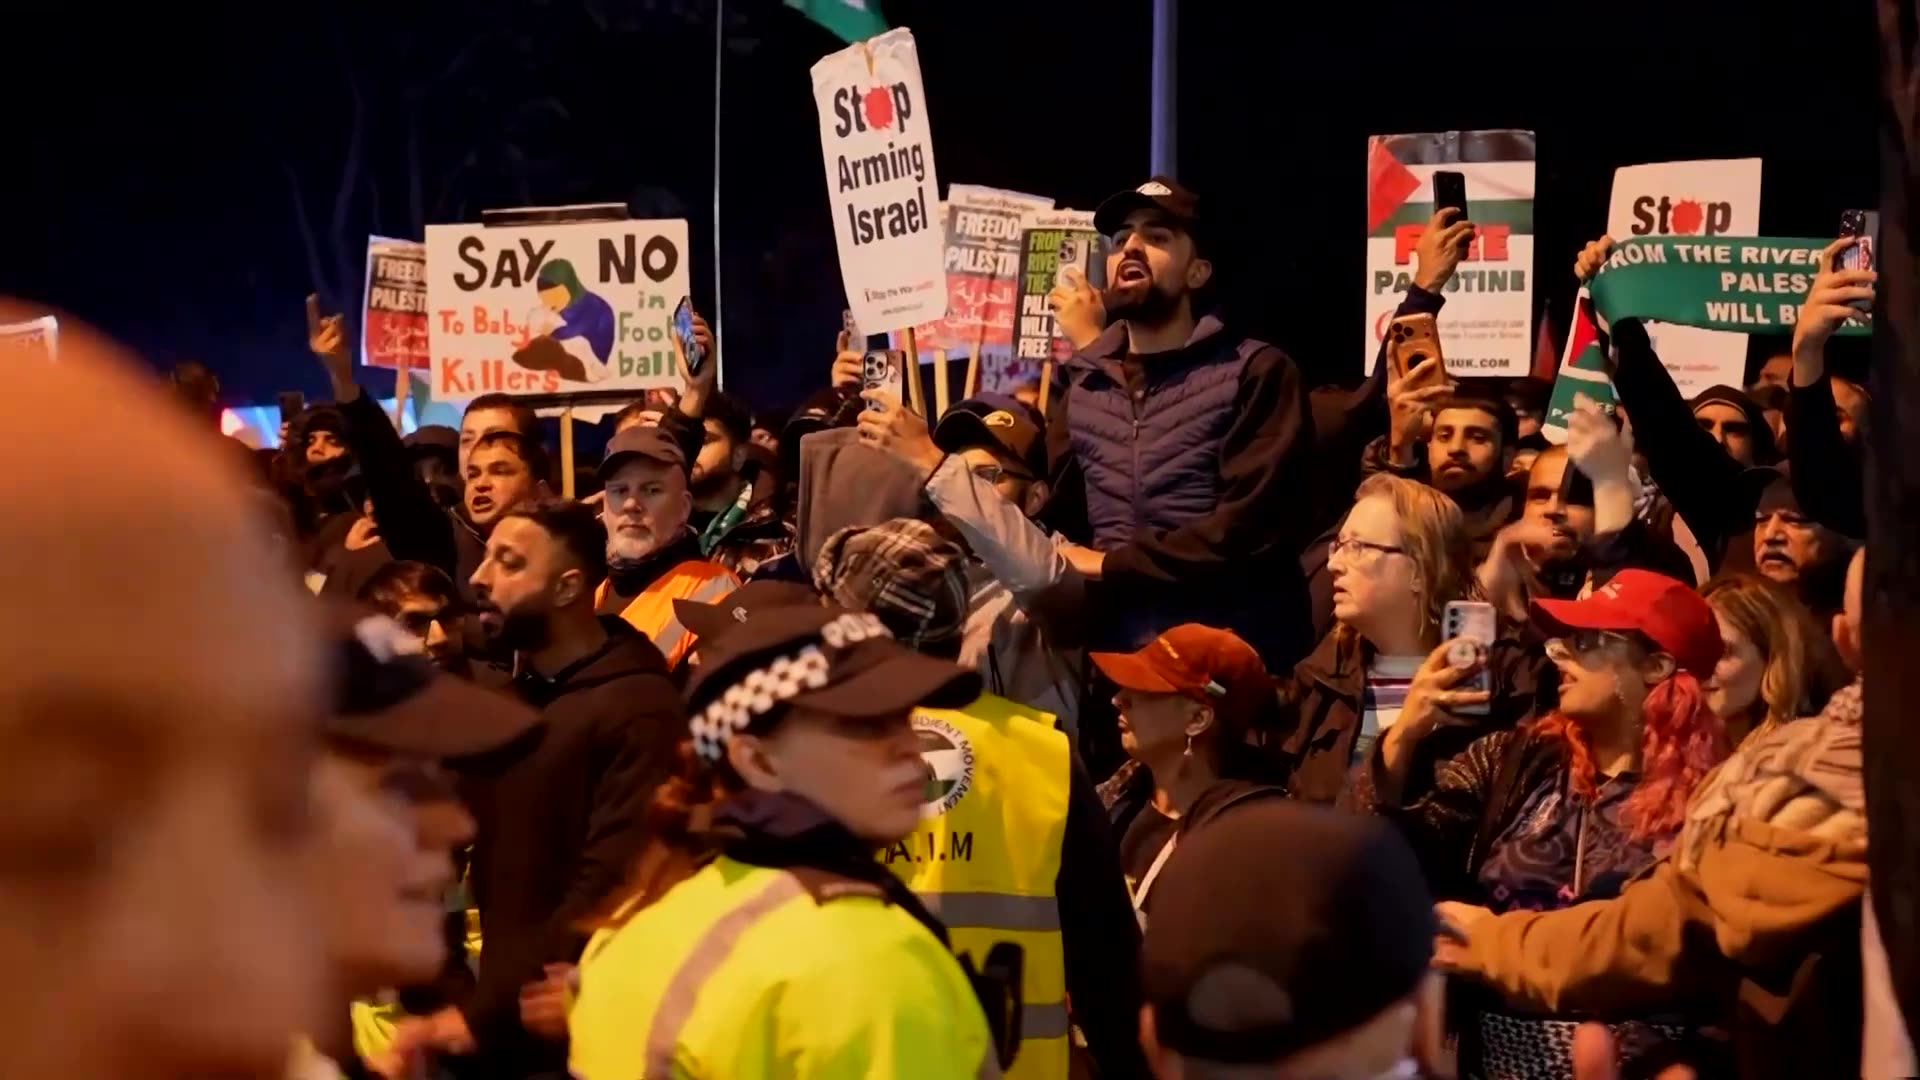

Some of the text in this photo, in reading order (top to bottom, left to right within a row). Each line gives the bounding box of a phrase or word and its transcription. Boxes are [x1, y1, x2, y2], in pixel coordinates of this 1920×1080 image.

[838, 142, 925, 194] Arming
[847, 186, 928, 246] Israel
[453, 234, 678, 291] SAY NO
[1674, 244, 1731, 264] THE
[1374, 270, 1526, 295] PASTINE
[638, 290, 665, 309] in
[1020, 315, 1049, 337] WILL
[1706, 302, 1771, 325] WILL
[438, 306, 530, 348] To Baby
[1017, 337, 1048, 359] FREE
[442, 358, 561, 394] Killers
